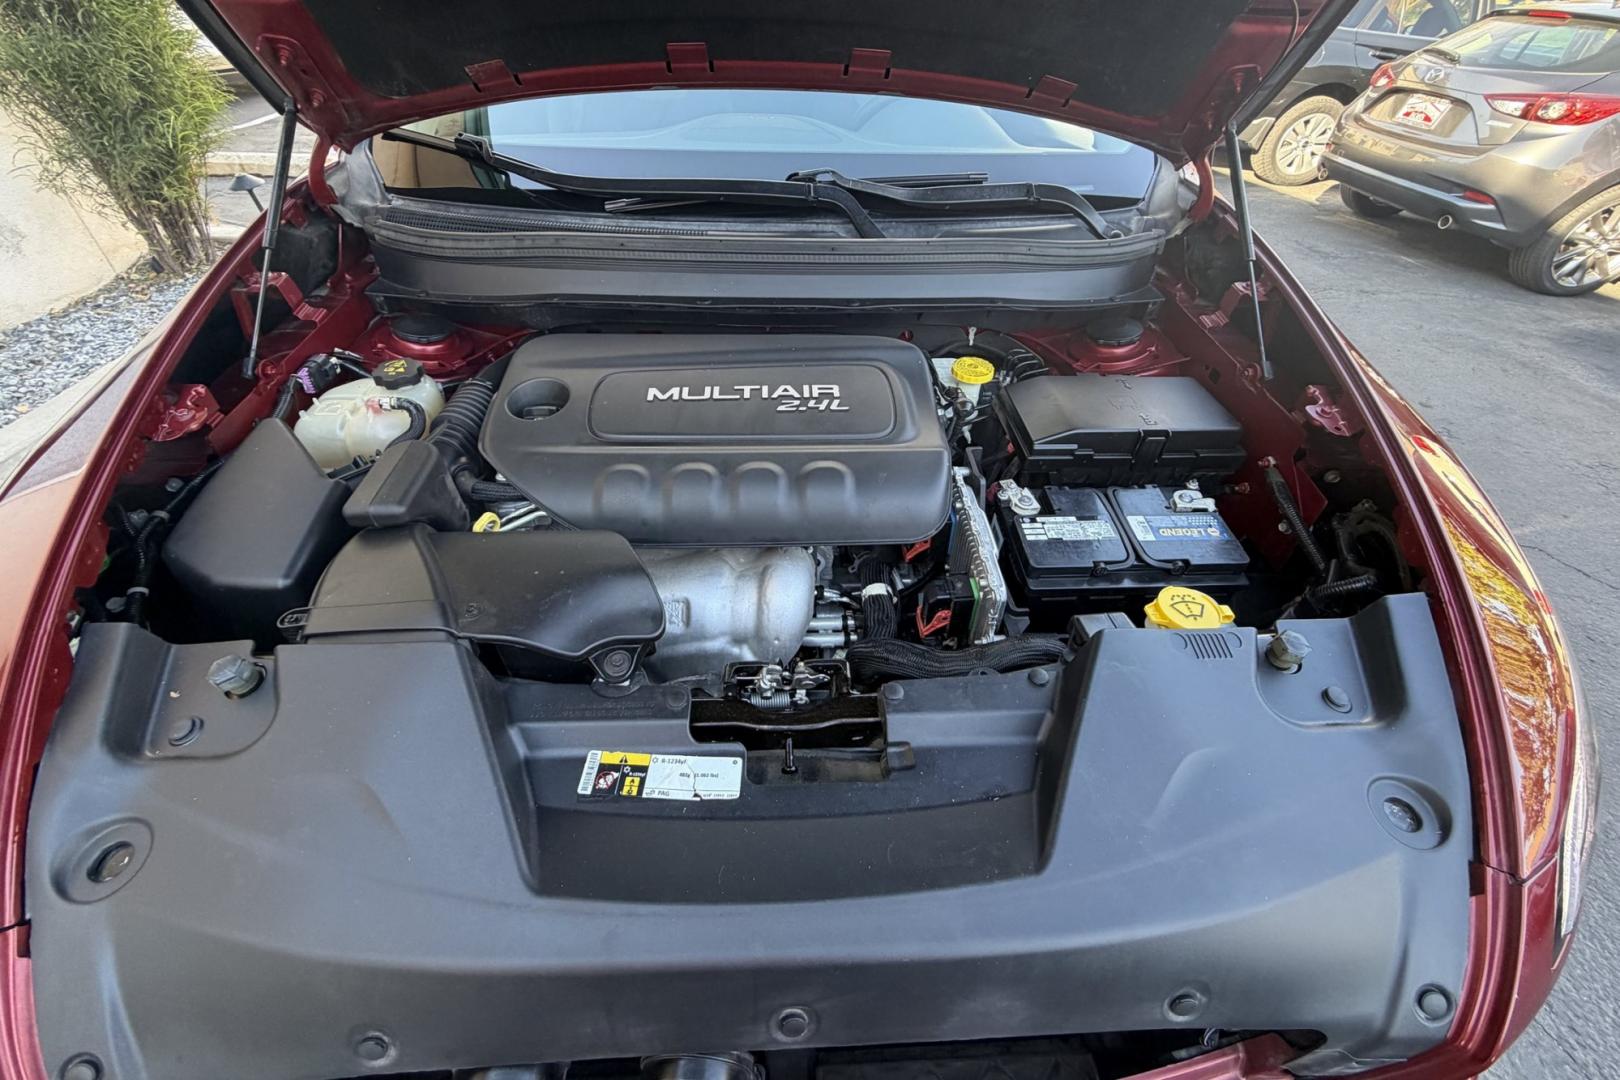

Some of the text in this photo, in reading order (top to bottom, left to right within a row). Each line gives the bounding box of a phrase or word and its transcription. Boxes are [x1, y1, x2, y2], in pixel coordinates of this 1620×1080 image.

[646, 384, 841, 400] MULTIAIR
[776, 399, 850, 411] 2.4L
[1160, 528, 1205, 537] LEGEND
